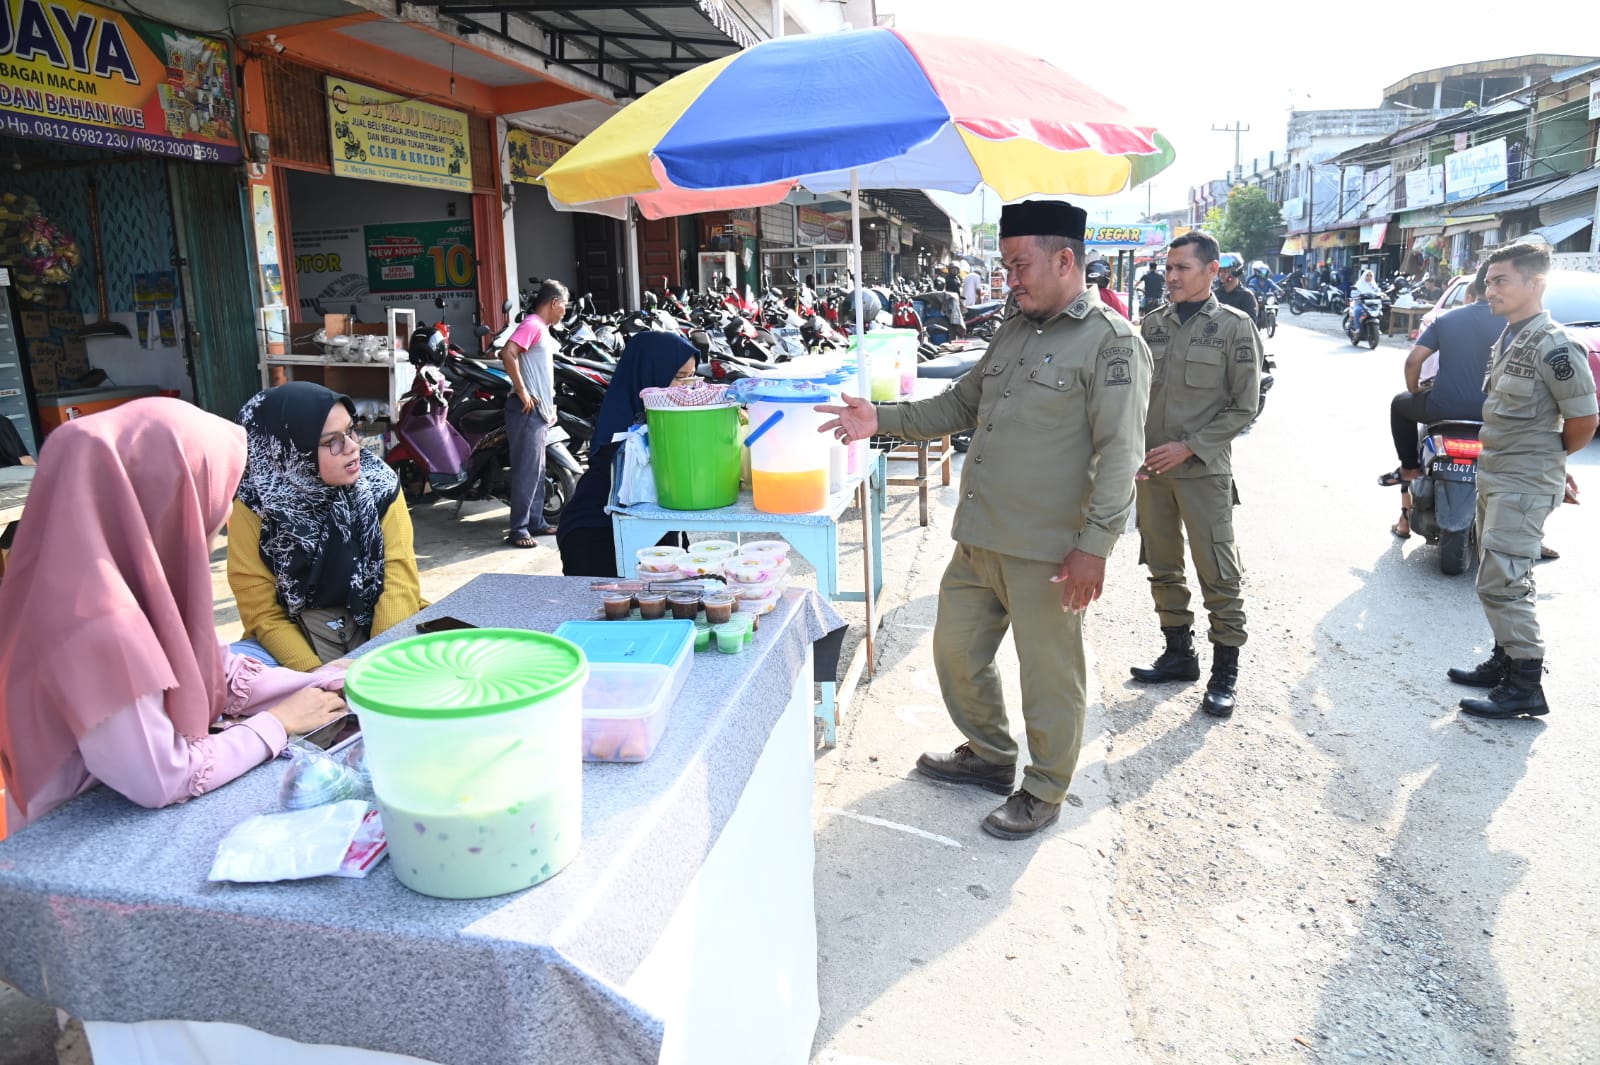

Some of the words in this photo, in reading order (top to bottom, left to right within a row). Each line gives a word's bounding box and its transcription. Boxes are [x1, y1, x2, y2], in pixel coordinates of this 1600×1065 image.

[47, 75, 97, 96] MACAM
[0, 84, 43, 112] DAN
[44, 92, 110, 124] BAHAN
[111, 104, 146, 129] KUE
[352, 116, 367, 128] JUAL
[367, 120, 381, 132] BELI
[381, 123, 404, 136] SEGALA
[7, 118, 33, 137] Hp.
[36, 120, 70, 140] 0812
[71, 128, 104, 146] 6982
[106, 132, 129, 149] 230
[136, 137, 165, 153] 0823
[168, 142, 193, 157] 2000
[367, 131, 381, 142] DAN
[408, 141, 425, 149] TUKAR
[369, 144, 398, 161] CASH
[400, 150, 407, 162] &
[409, 153, 446, 168] KREDIT
[1097, 227, 1142, 242] SEGAR
[368, 247, 393, 258] NEW
[427, 245, 475, 287] 10
[1523, 368, 1534, 377] PP
[1433, 462, 1444, 471] BL
[1447, 463, 1470, 473] 4047
